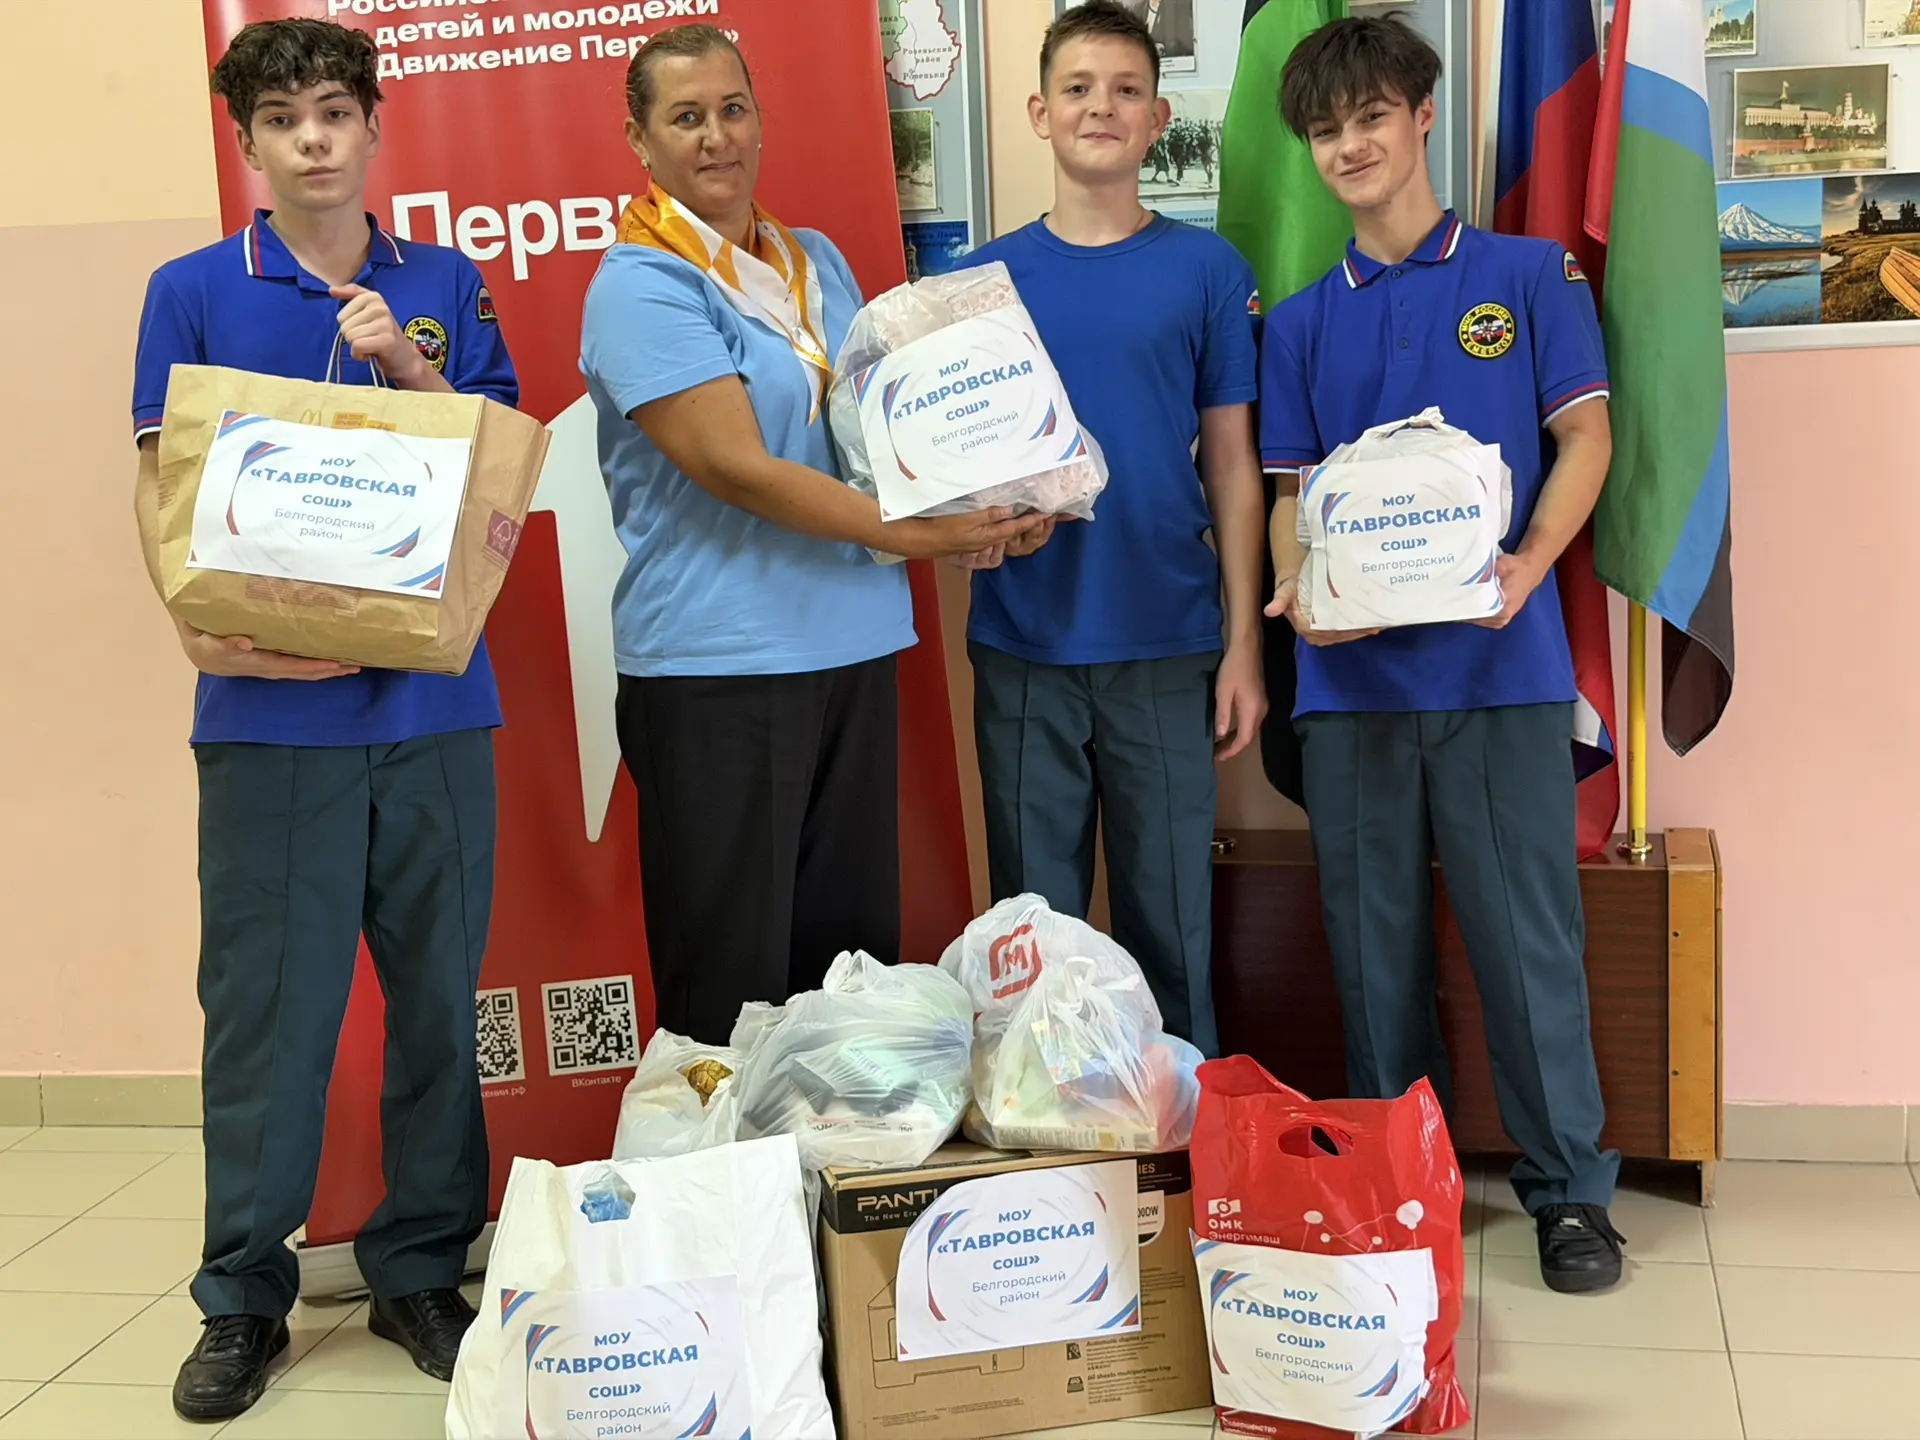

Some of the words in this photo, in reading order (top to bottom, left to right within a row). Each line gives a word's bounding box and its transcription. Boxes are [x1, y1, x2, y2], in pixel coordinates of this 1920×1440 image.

[375, 12, 485, 49] детей
[492, 15, 515, 35] и
[524, 0, 719, 31] молодежи
[376, 43, 572, 82] Движение
[392, 191, 632, 281] Перв
[1474, 305, 1509, 320] РОССИИ
[939, 358, 969, 378] МОУ
[893, 360, 1033, 421] «ТАВРОВСКАЯ
[946, 399, 990, 422] СОШ»
[932, 411, 1019, 447] Белгородский
[961, 433, 999, 453] район
[320, 457, 356, 468] МОУ
[251, 467, 417, 498] «ТАВРОВСКАЯ
[302, 494, 352, 508] СОШ»
[1382, 494, 1416, 507] МОУ
[275, 509, 375, 531] Белгородский
[1328, 505, 1481, 535] «ТАВРОВСКАЯ
[299, 528, 343, 541] район
[1381, 538, 1427, 552] СОШ»
[1361, 553, 1455, 573] Белгородский
[1390, 572, 1429, 586] район
[572, 1076, 622, 1088] ВКонтакте
[1138, 1162, 1156, 1174] IES
[864, 1213, 880, 1222] The
[882, 1212, 901, 1221] New
[903, 1210, 918, 1218] Era
[998, 1209, 1032, 1223] МОУ
[1208, 1218, 1243, 1230] ОМК
[937, 1221, 1095, 1253] «ТАВРОВСКАЯ
[1208, 1231, 1280, 1244] Энергомаш
[993, 1255, 1040, 1270] СОШ»
[972, 1271, 1066, 1293] Белгородский
[1000, 1291, 1039, 1305] район
[1283, 1288, 1318, 1302] МОУ
[1221, 1298, 1386, 1330] «ТАВРОВСКАЯ
[594, 1332, 631, 1347] МОУ
[1277, 1332, 1326, 1349] СОШ»
[534, 1345, 698, 1374] «ТАВРОВСКАЯ
[1255, 1348, 1353, 1372] Белгородский
[1283, 1368, 1325, 1384] район
[589, 1383, 642, 1398] СОШ»
[567, 1402, 671, 1421] Белгородский
[597, 1423, 641, 1437] район
